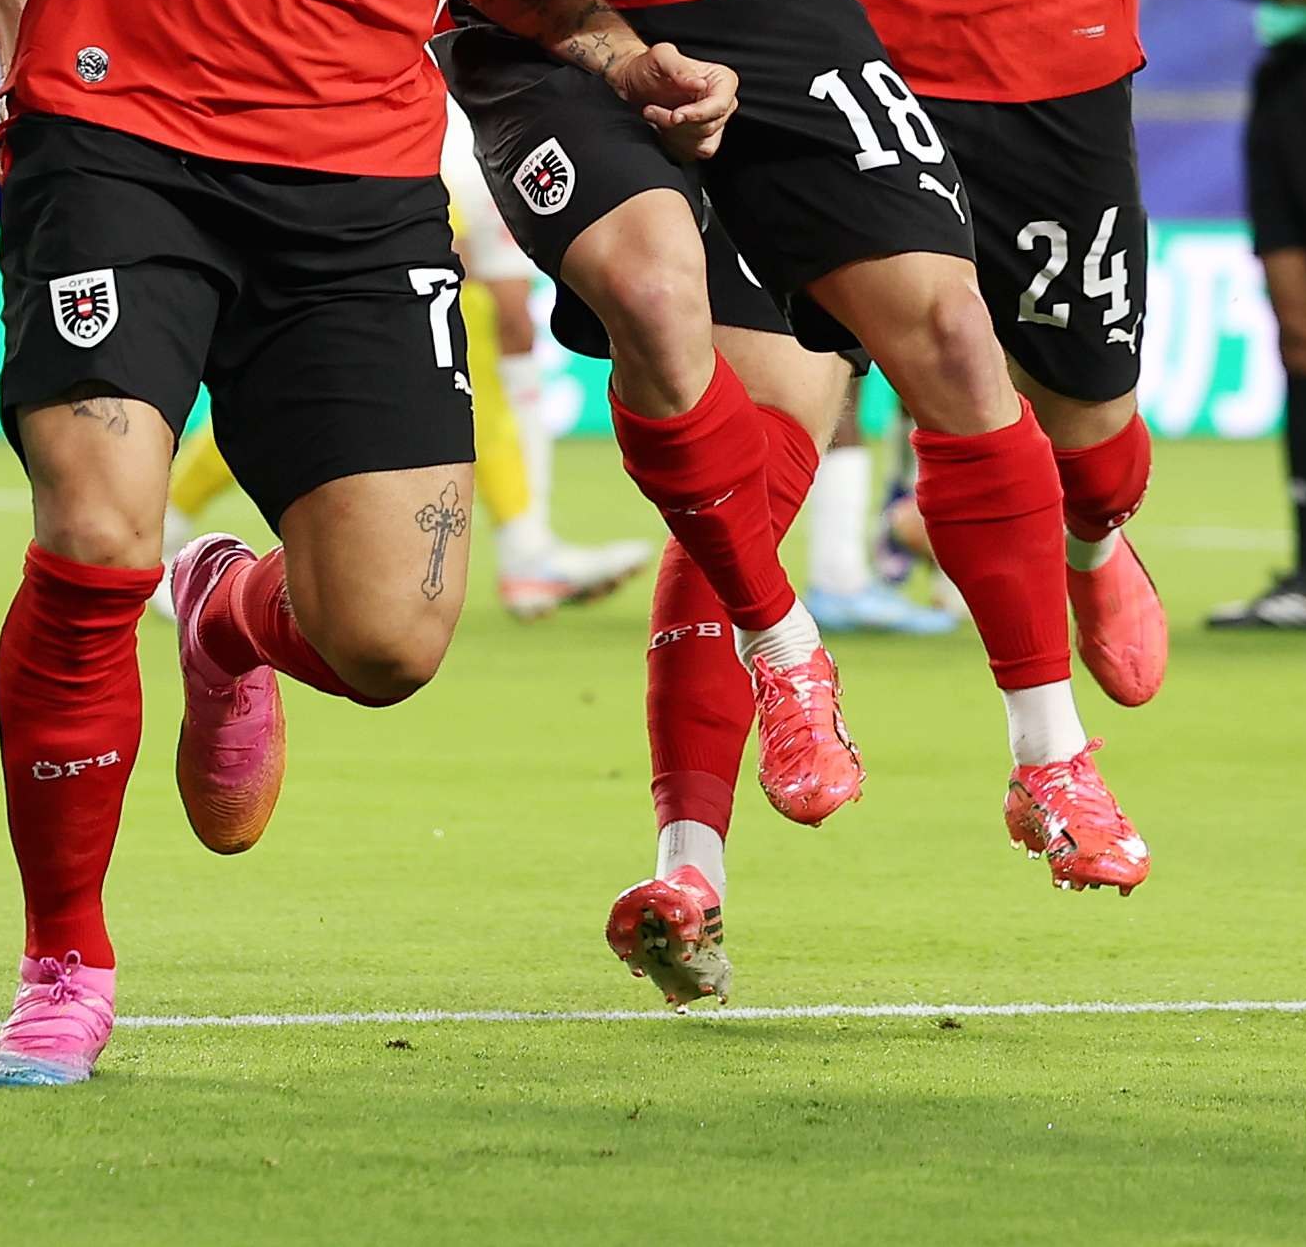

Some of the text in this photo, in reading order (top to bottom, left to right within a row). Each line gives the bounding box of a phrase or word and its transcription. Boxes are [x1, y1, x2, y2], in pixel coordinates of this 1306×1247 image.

[809, 60, 946, 171] 18
[408, 268, 459, 368] 7
[1017, 206, 1130, 329] 24
[32, 750, 121, 781] ÖFB
